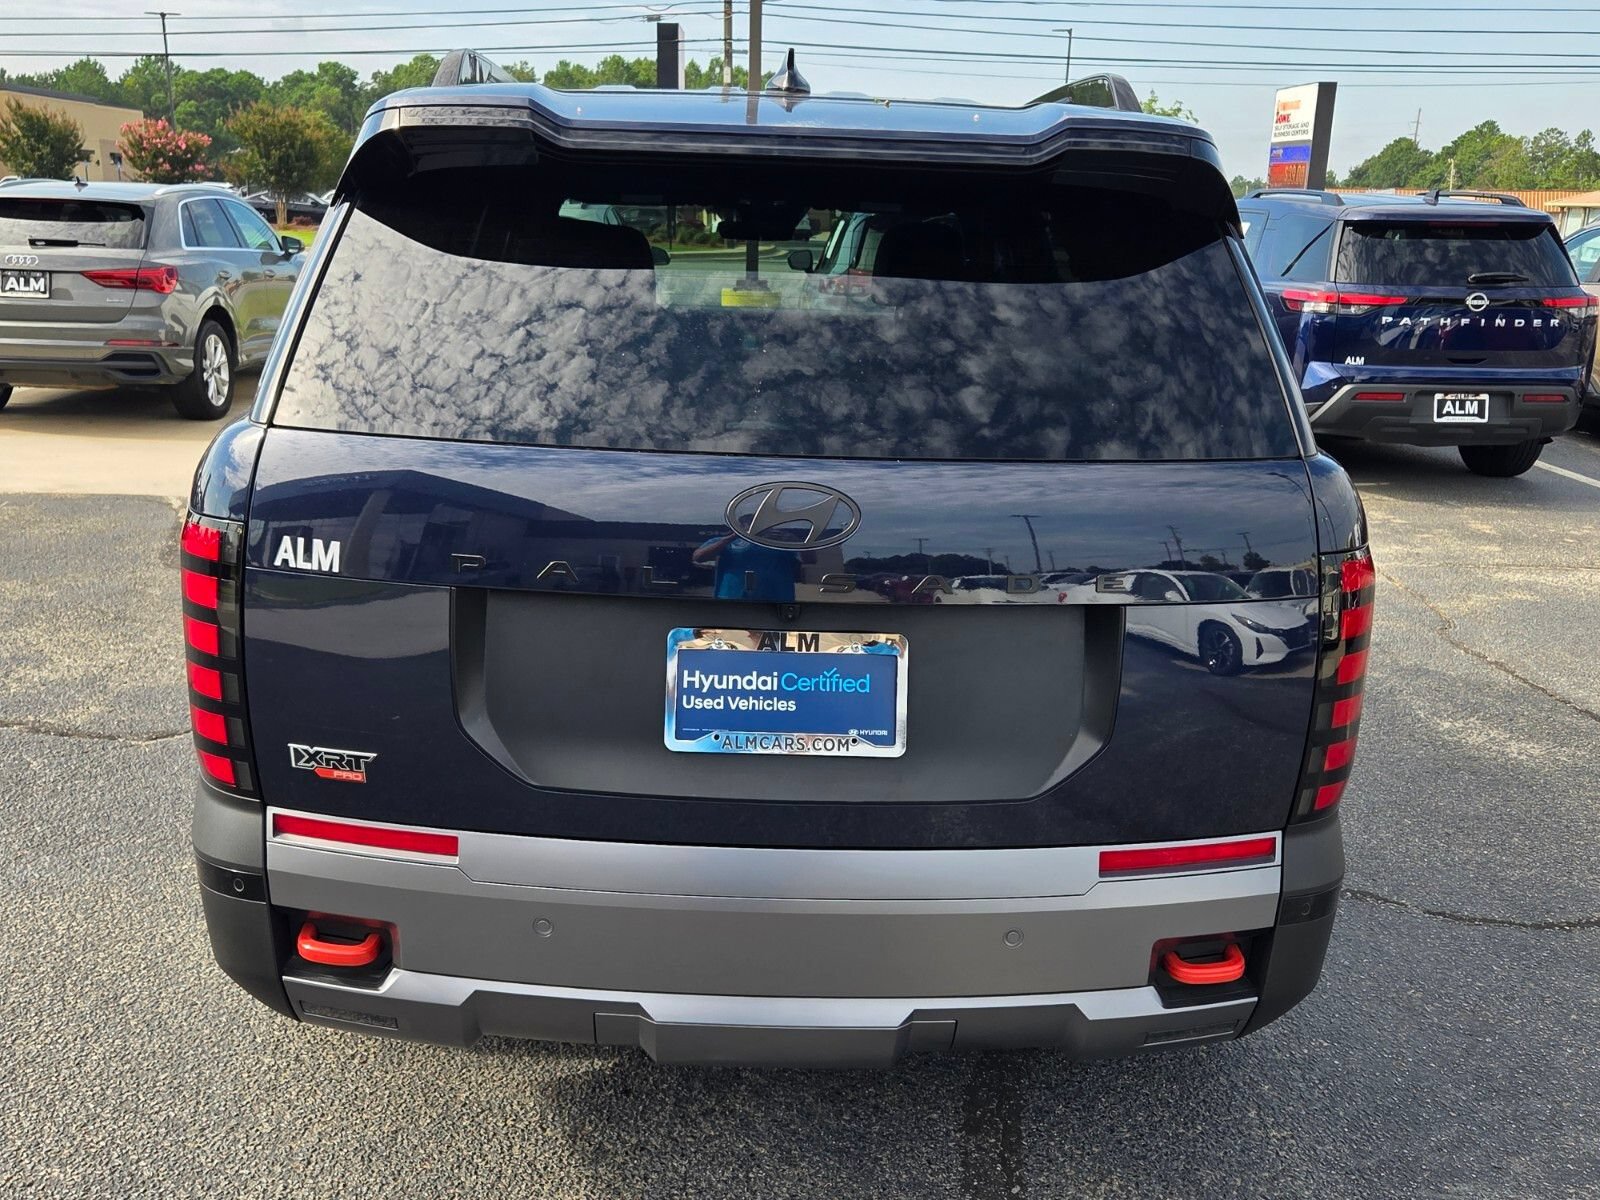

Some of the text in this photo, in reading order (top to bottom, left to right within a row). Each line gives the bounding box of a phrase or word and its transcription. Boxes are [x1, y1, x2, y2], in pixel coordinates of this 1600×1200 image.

[5, 277, 45, 292] ALM
[1381, 316, 1560, 327] PATHFINDER
[1345, 356, 1364, 365] ALM
[1442, 400, 1479, 414] ALM
[273, 535, 341, 573] ALM
[451, 553, 1129, 593] PALISADE
[757, 632, 820, 653] ALM
[683, 668, 870, 693] Hyundai Certified
[682, 695, 797, 712] Used Vehicles
[721, 734, 850, 752] ALMCARS.COM
[288, 743, 377, 773] XRT
[333, 770, 363, 781] PRO
